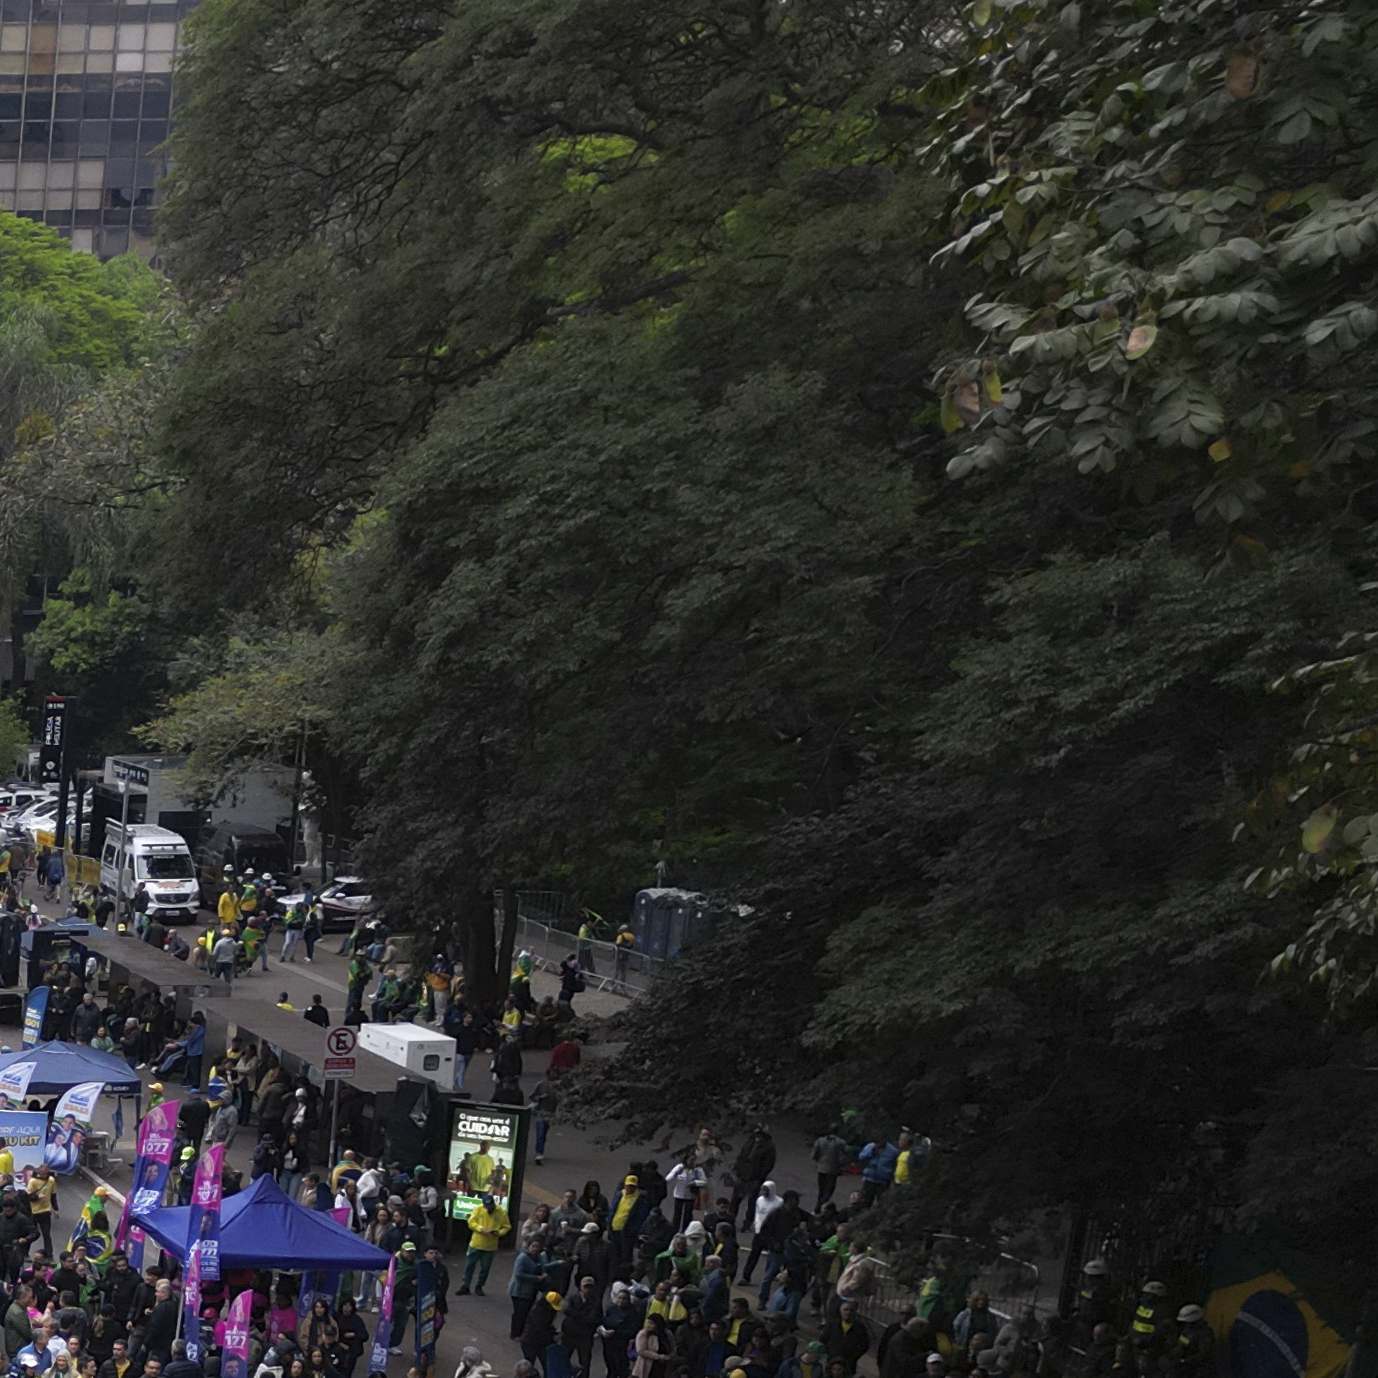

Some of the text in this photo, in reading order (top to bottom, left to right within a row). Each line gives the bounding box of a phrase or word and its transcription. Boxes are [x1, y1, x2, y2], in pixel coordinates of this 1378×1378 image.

[17, 1126, 41, 1135] AQUI
[458, 1121, 510, 1137] CUIDAR
[20, 1136, 41, 1146] KIT
